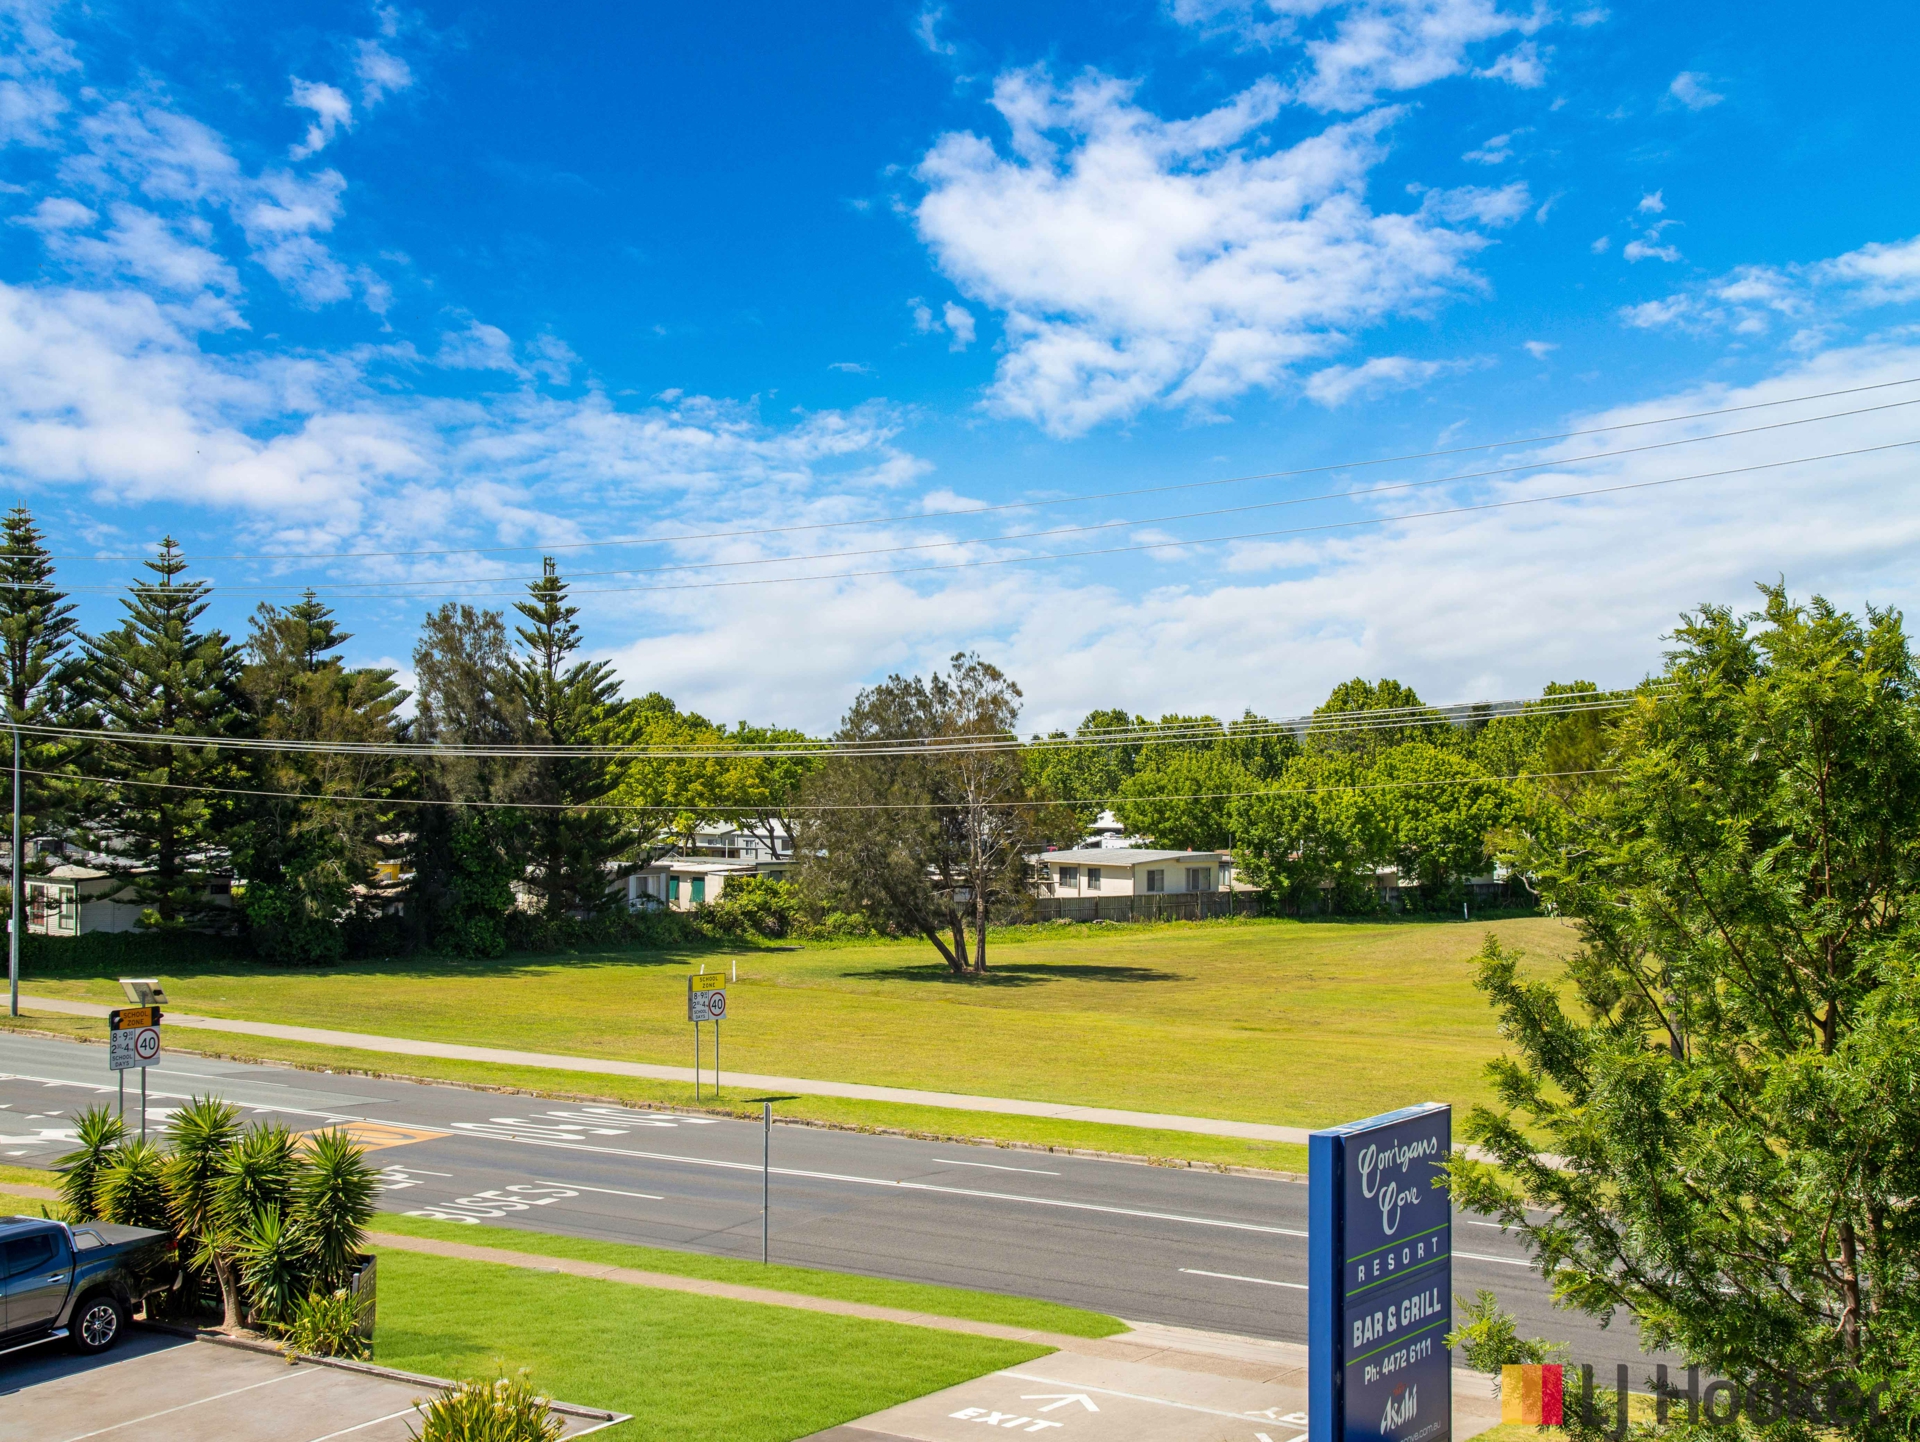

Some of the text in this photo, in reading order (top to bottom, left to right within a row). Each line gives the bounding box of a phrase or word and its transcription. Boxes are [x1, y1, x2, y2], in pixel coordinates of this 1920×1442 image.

[123, 1011, 149, 1019] SCHOOL
[127, 1018, 144, 1026] ZONE
[711, 998, 722, 1009] 40
[140, 1037, 156, 1050] 40
[1358, 1136, 1438, 1198] Corrigans
[1378, 1181, 1422, 1235] Cove
[1358, 1237, 1439, 1283] RESORT
[1353, 1287, 1442, 1348] BAR & GRILL
[1364, 1337, 1431, 1386] Ph: 4472 6111
[947, 1406, 1065, 1432] EXIT
[1380, 1383, 1418, 1435] Asahi
